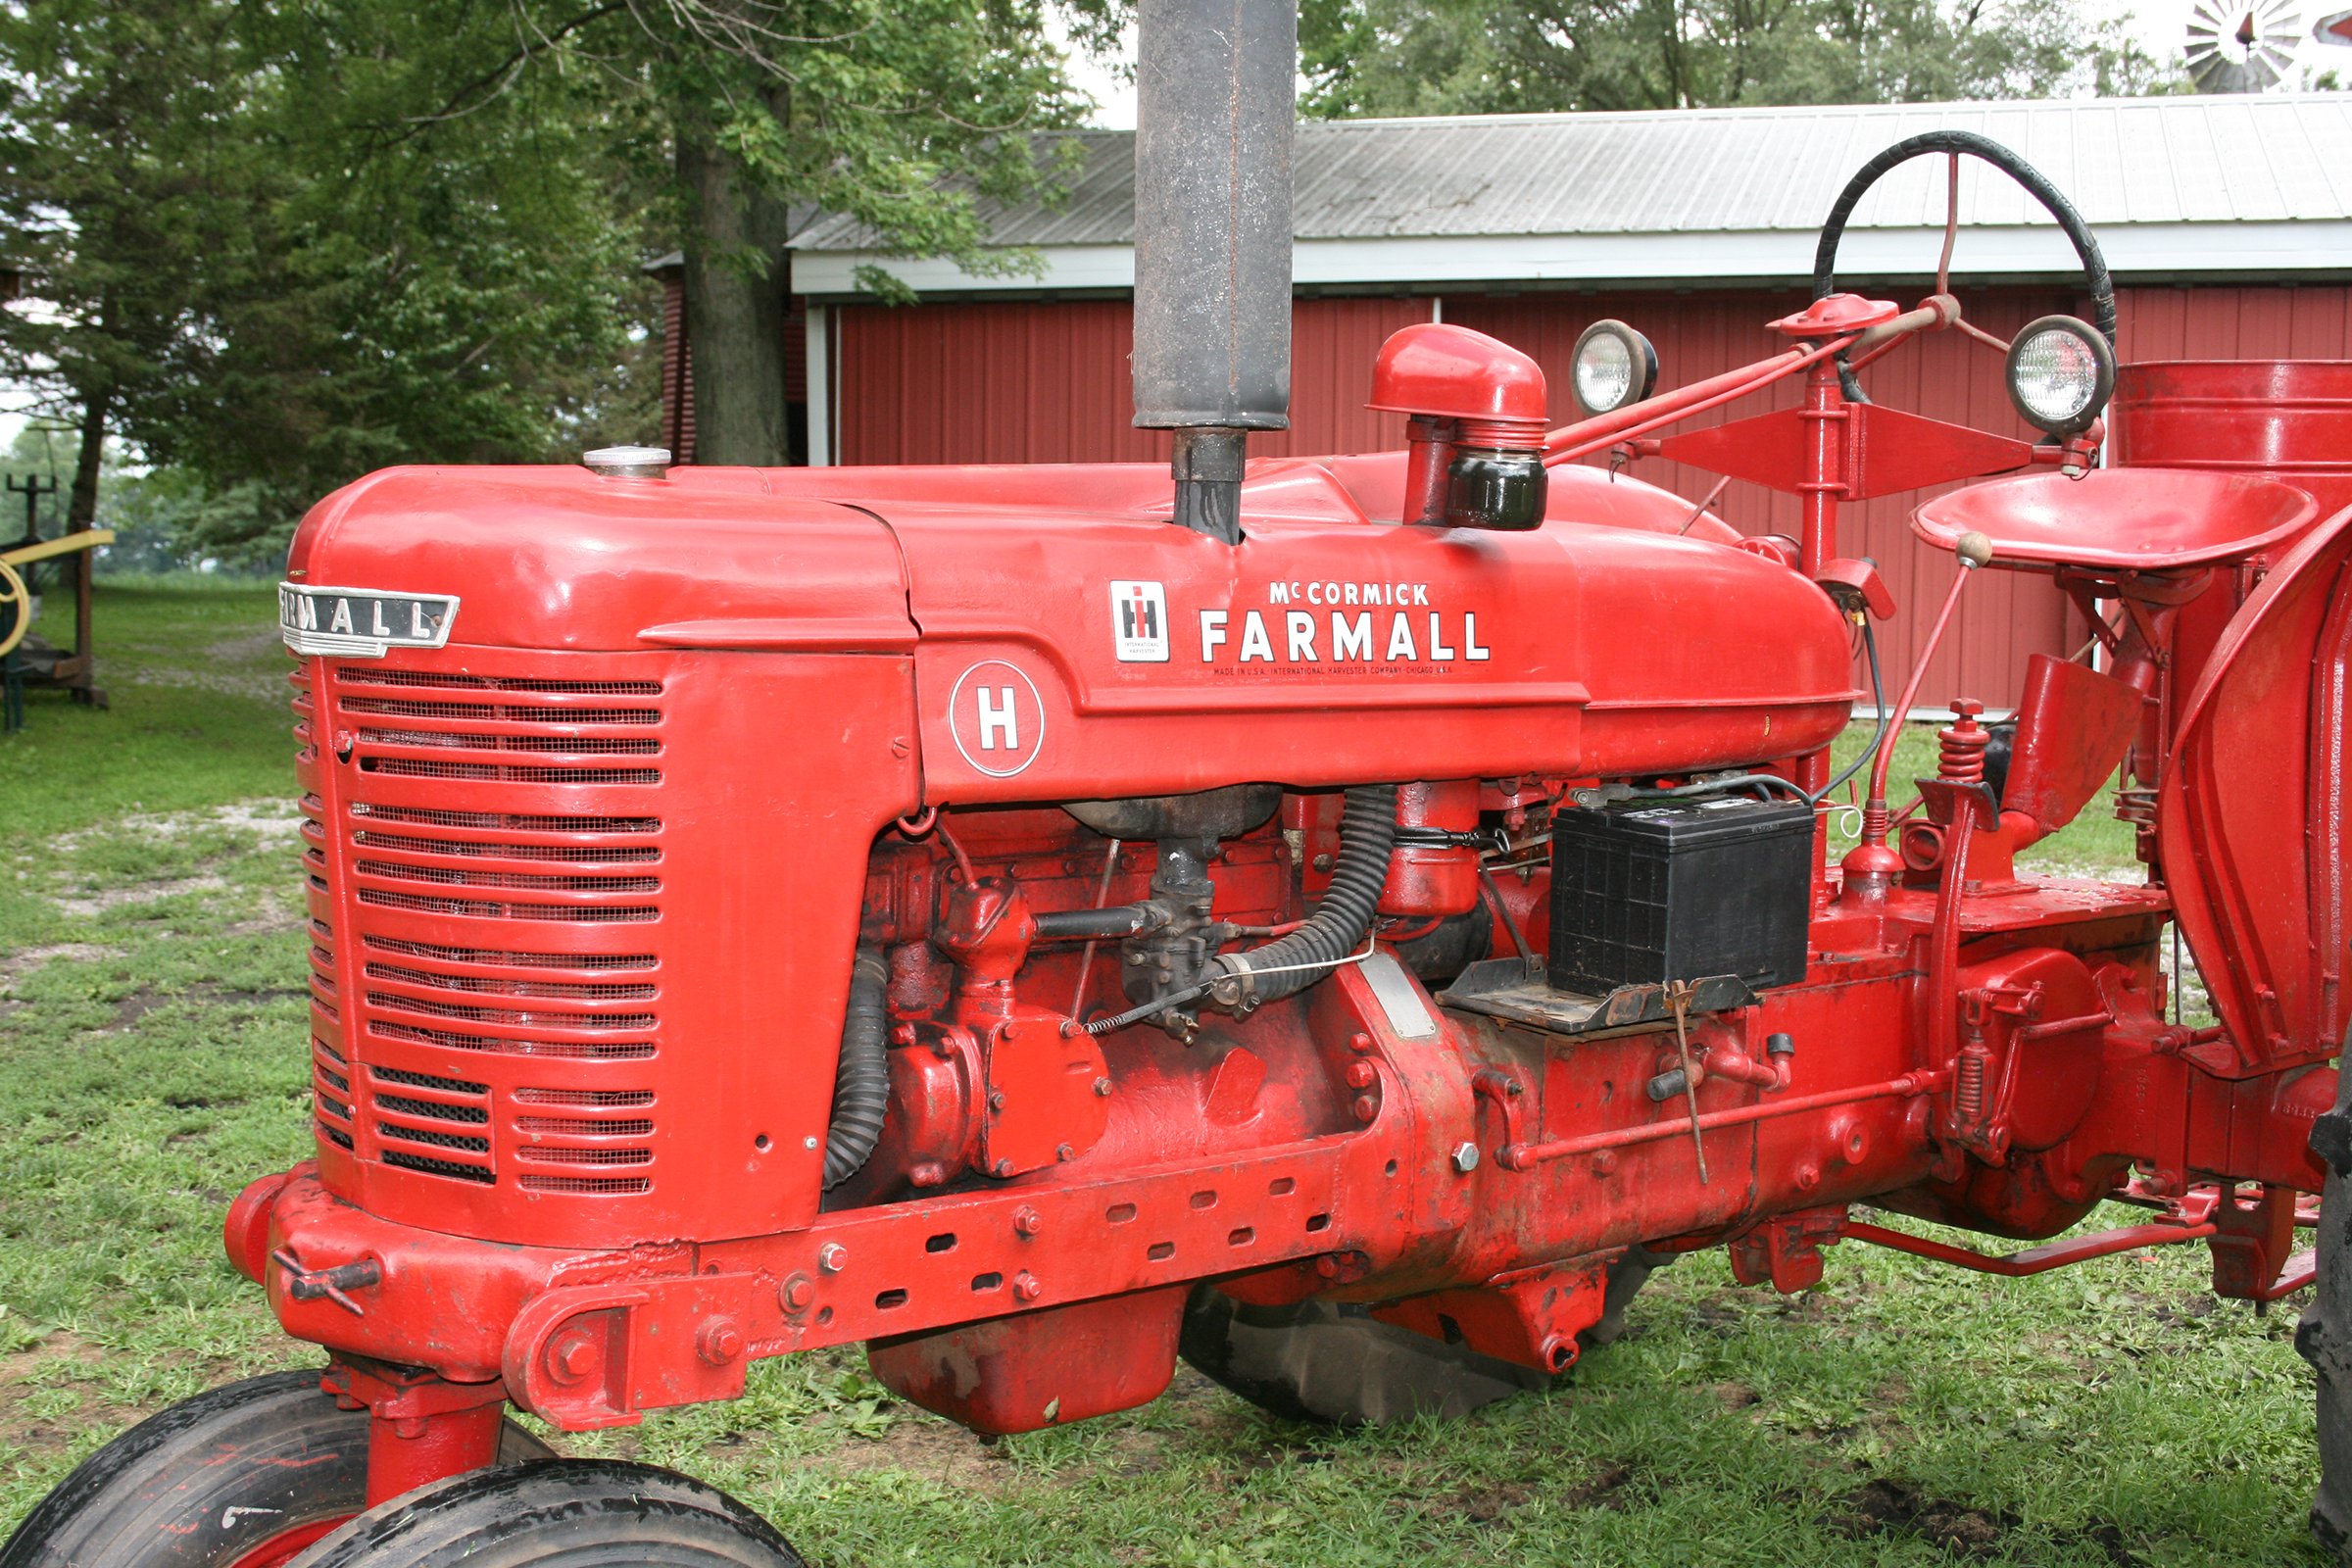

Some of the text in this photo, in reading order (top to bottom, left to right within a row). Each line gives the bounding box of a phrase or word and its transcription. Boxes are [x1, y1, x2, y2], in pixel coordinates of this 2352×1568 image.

[1199, 609, 1491, 663] FARMALL
[1213, 667, 1234, 676] MADE
[1328, 666, 1367, 675] HARVESTER
[976, 686, 1019, 751] H
